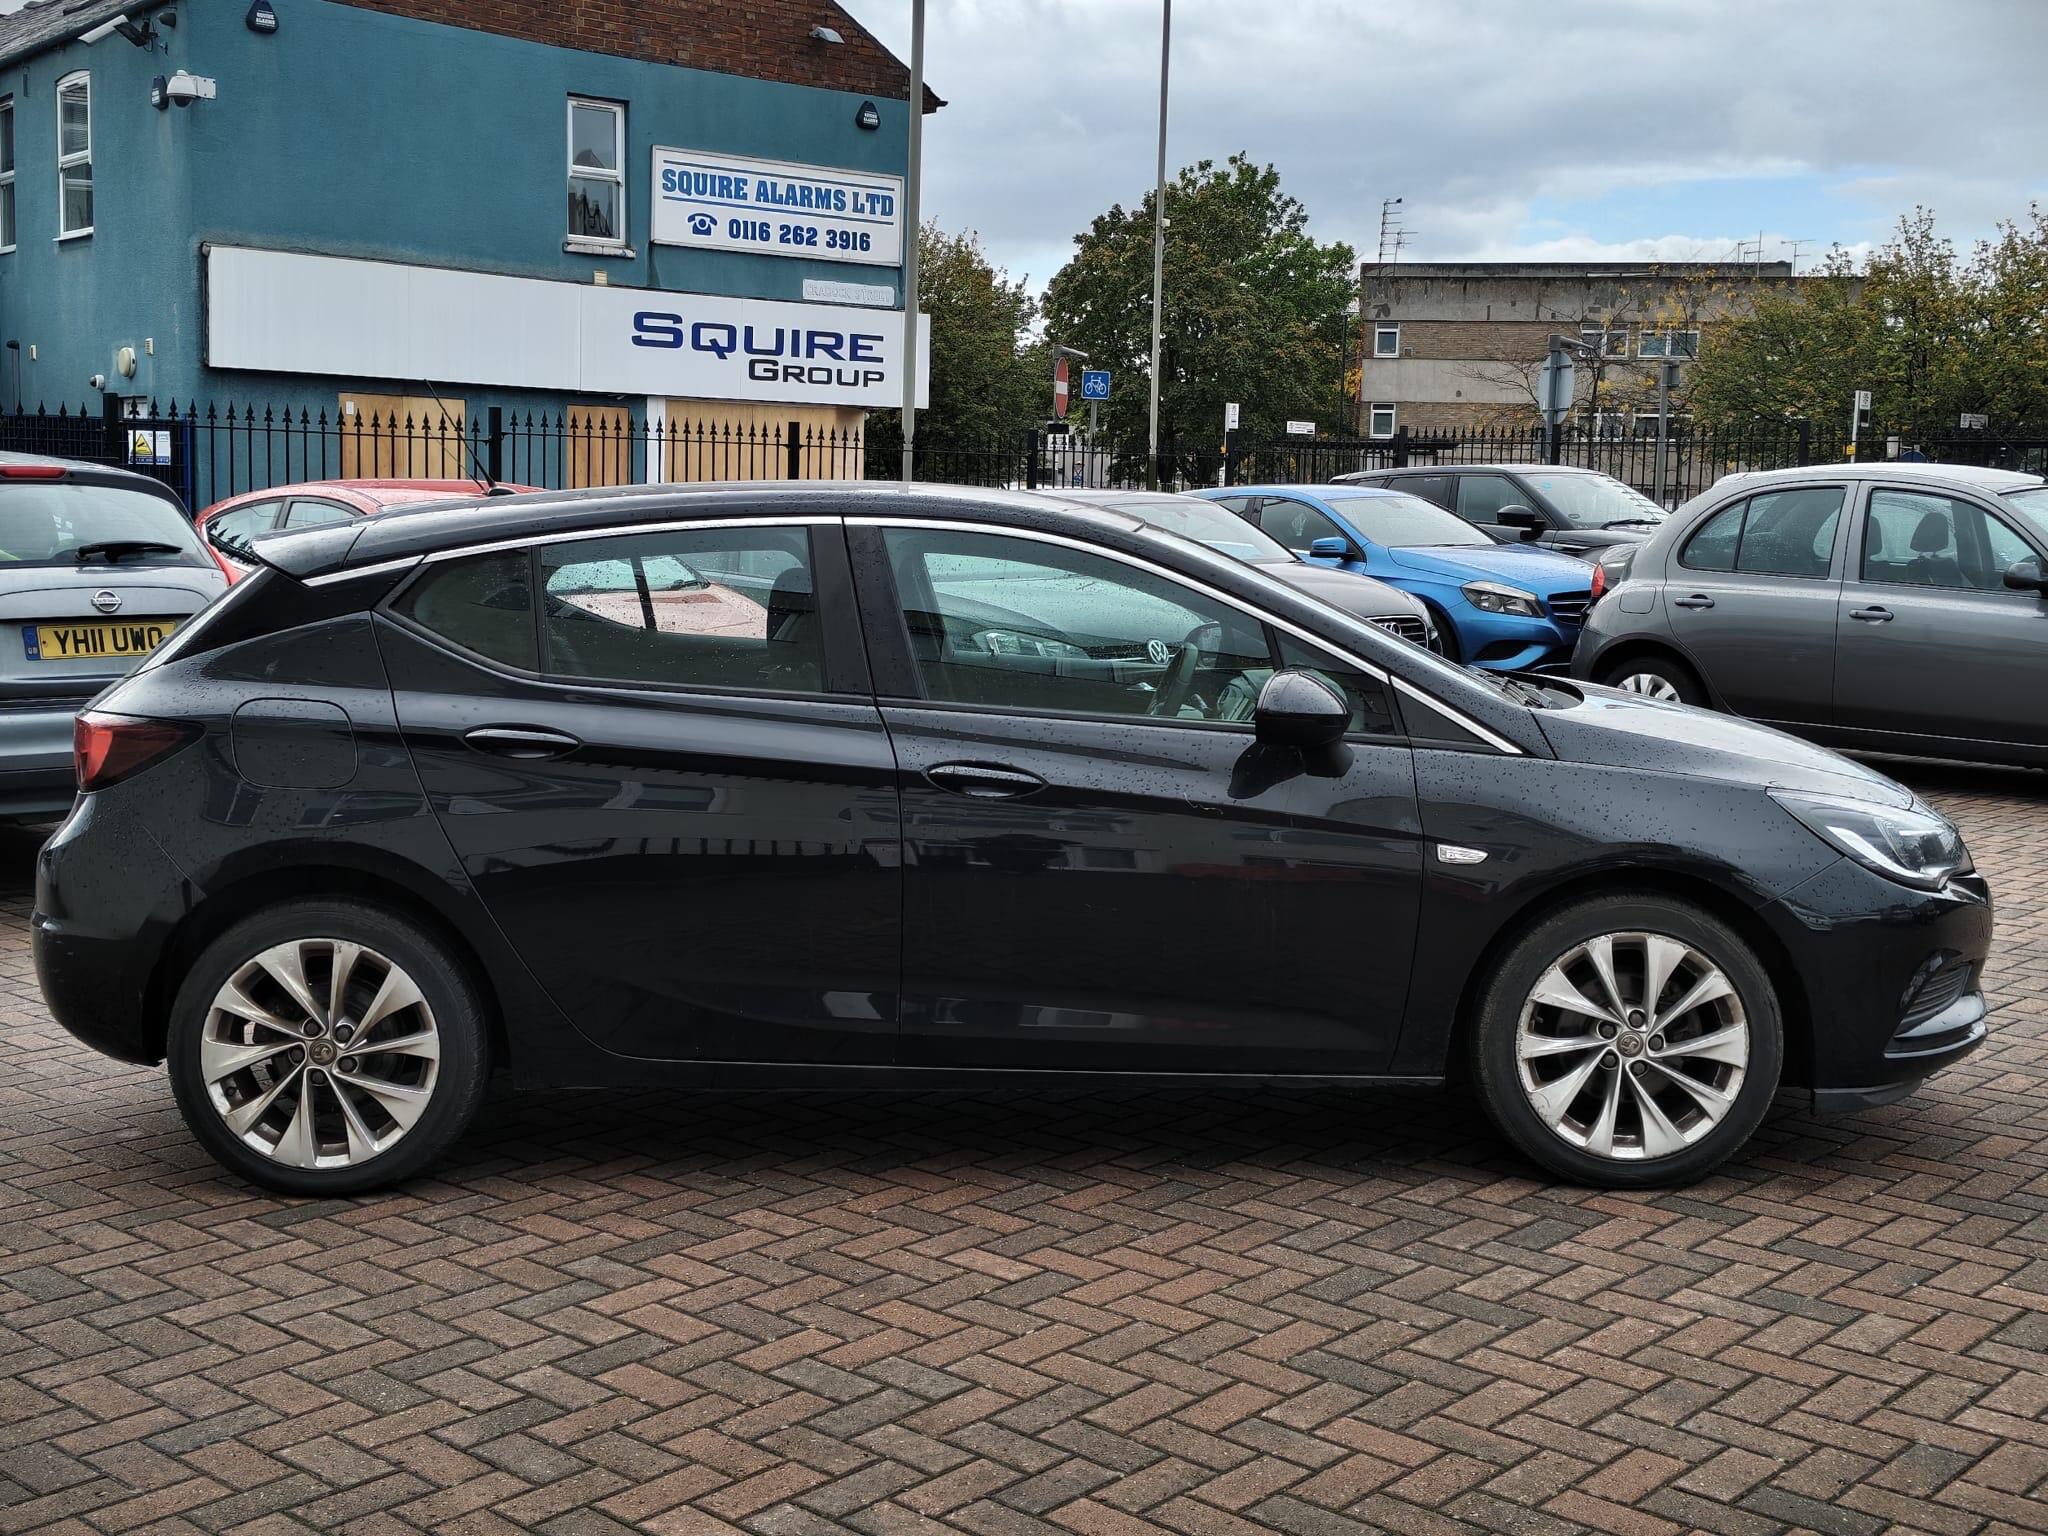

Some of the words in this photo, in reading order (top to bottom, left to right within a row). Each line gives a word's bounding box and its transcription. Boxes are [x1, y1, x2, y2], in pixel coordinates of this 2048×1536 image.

[662, 168, 748, 200] SQUIRE
[755, 180, 846, 212] ALARMS
[852, 192, 894, 217] LTD
[728, 218, 770, 242] 0116
[779, 224, 818, 247] 262
[825, 229, 871, 252] 3916
[632, 311, 884, 363] SQUIRE
[748, 359, 885, 387] GROUP
[53, 628, 105, 654] YH11
